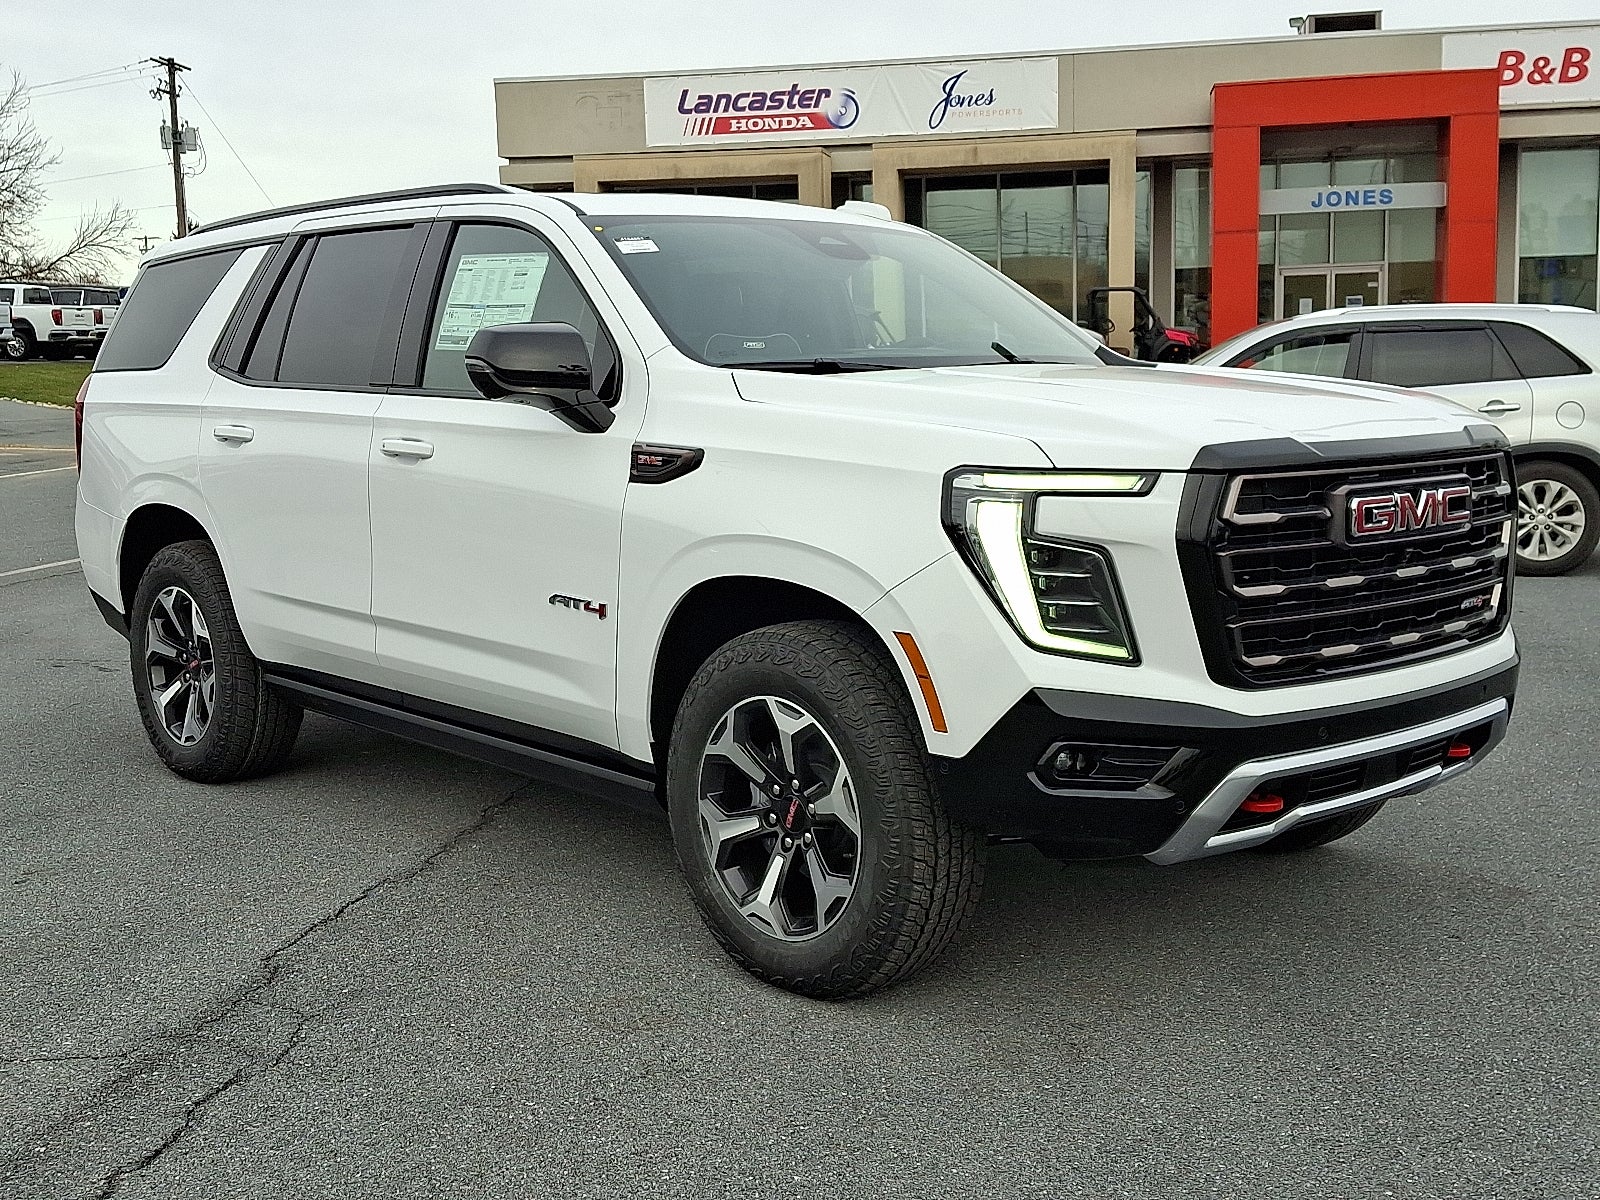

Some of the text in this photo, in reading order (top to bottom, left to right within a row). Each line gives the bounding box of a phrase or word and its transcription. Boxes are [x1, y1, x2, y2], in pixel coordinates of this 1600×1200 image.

[1498, 47, 1591, 86] B&B
[677, 83, 831, 115] Lancaster
[928, 69, 997, 130] Jones
[951, 108, 1024, 119] POWERSPORTS
[728, 115, 815, 132] HONDA
[1311, 188, 1394, 208] JONES
[1351, 485, 1471, 537] GMC
[549, 593, 608, 620] AT4
